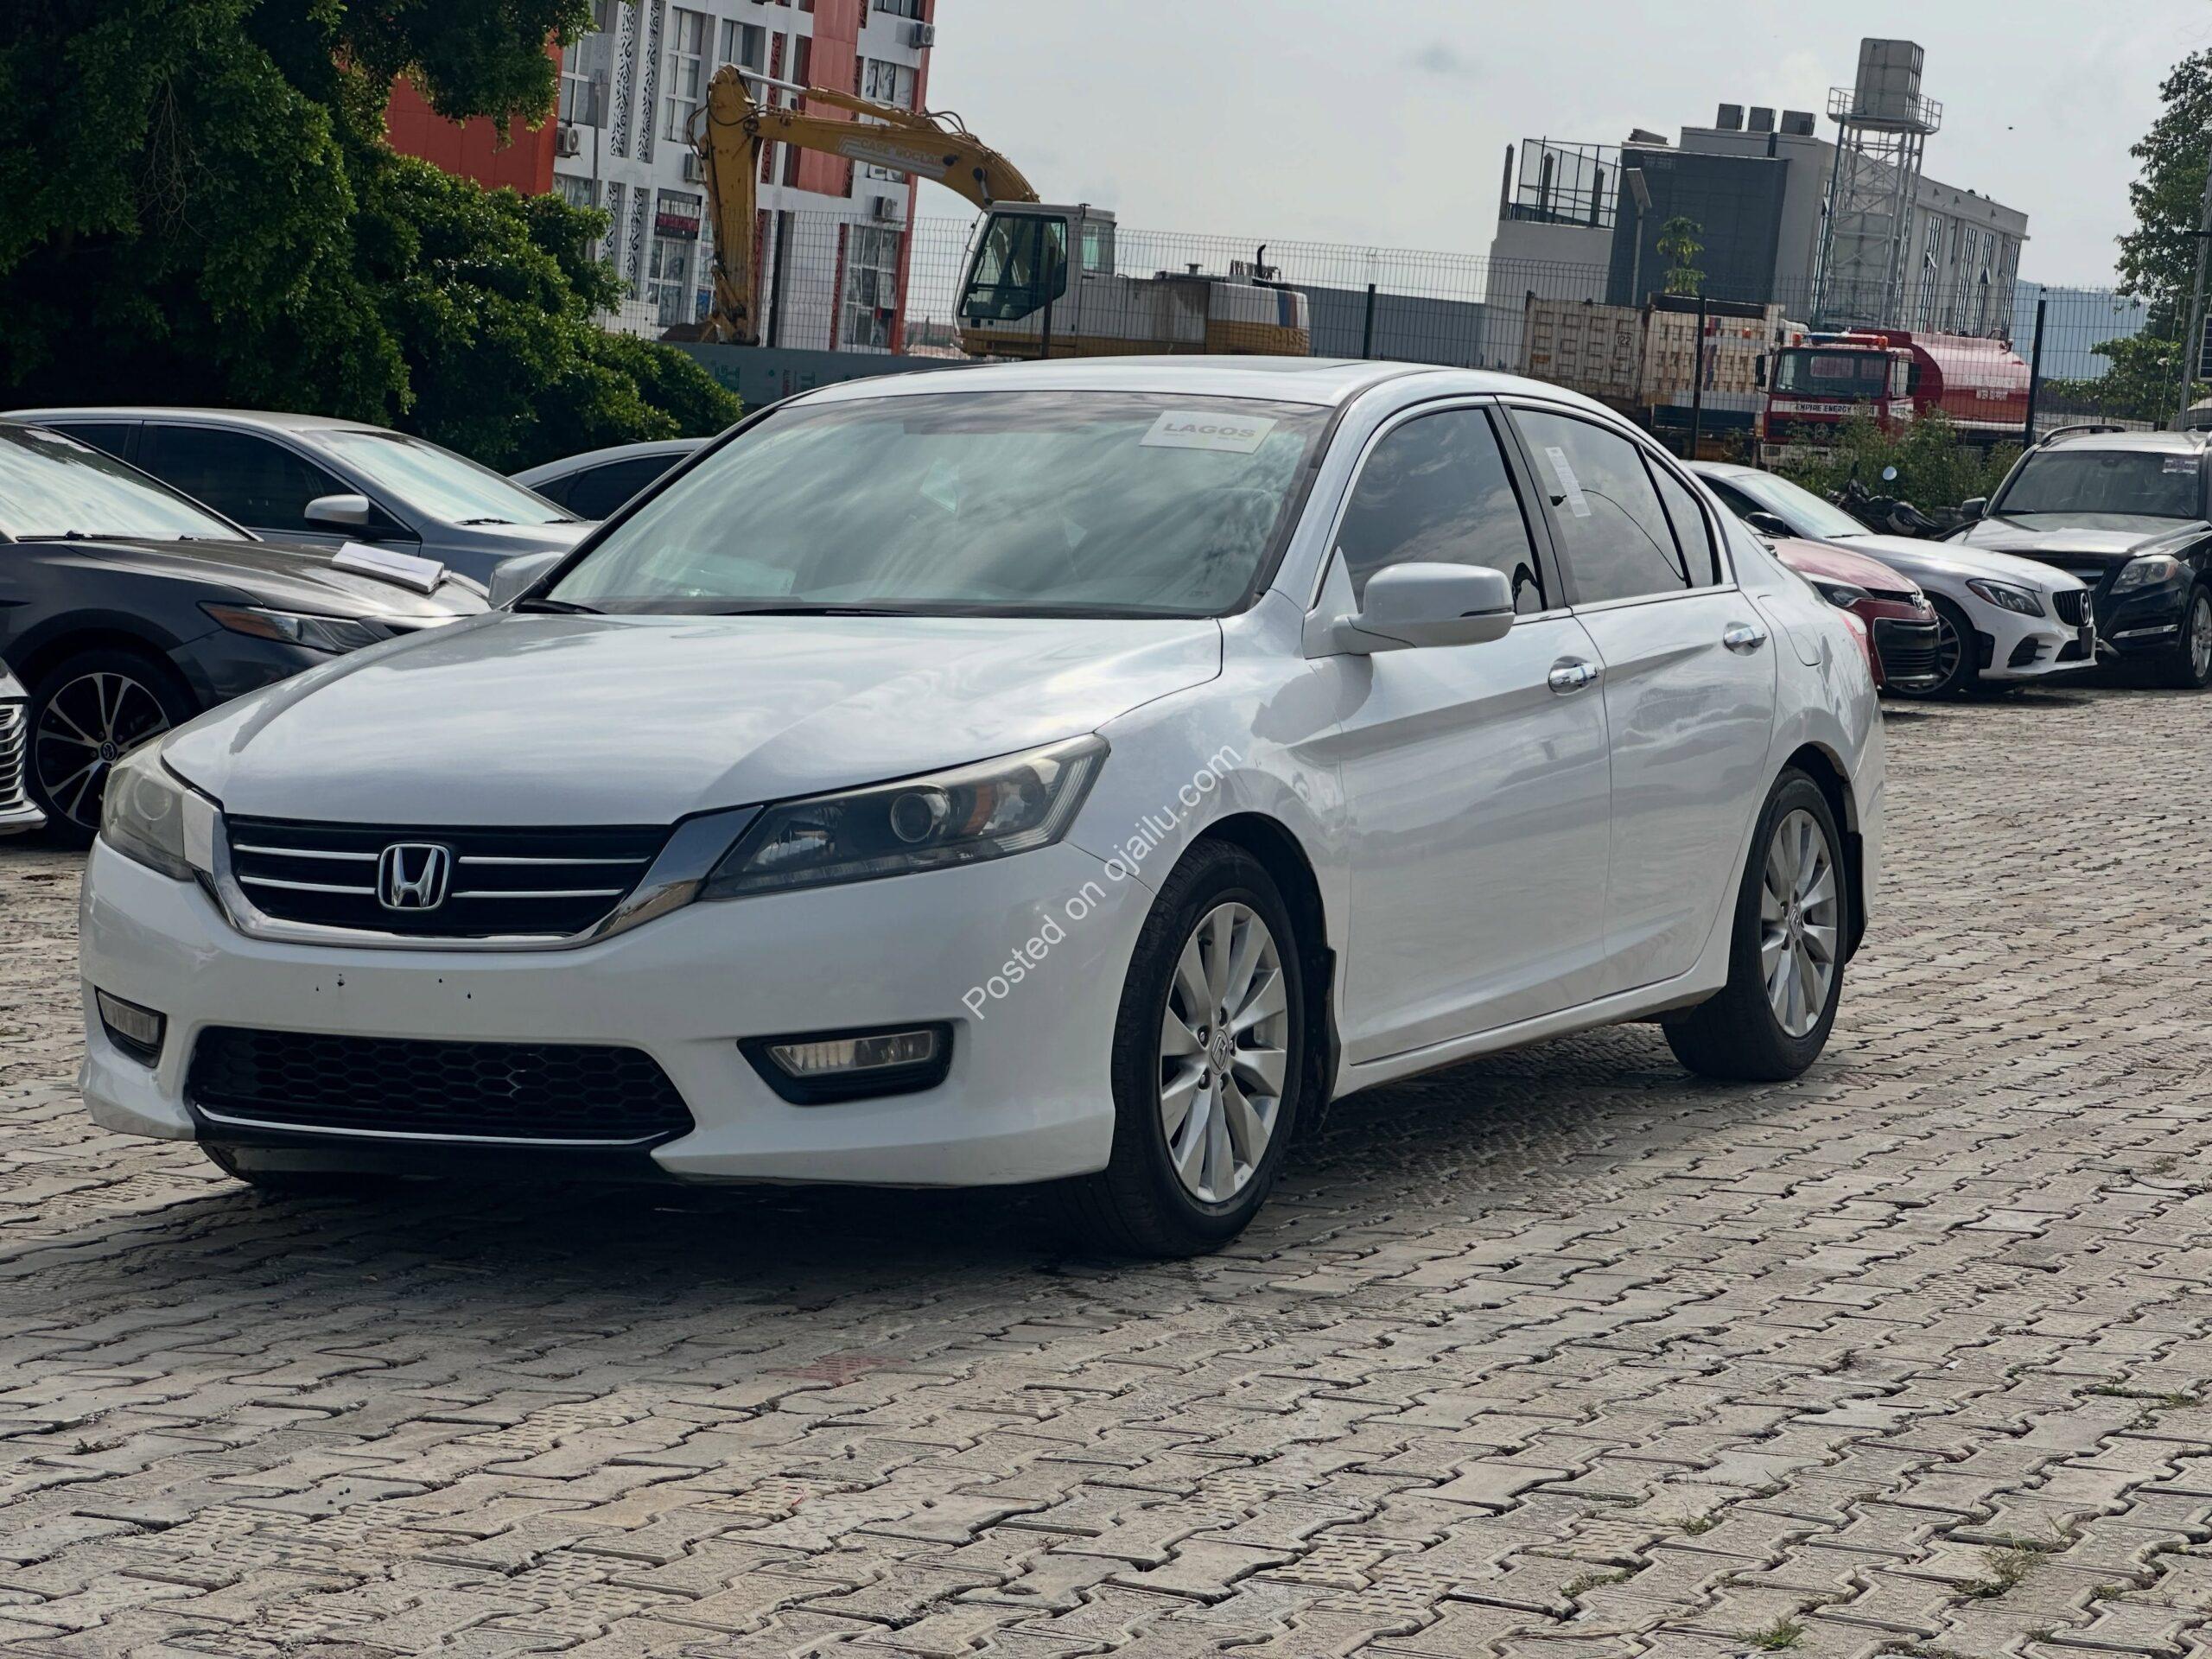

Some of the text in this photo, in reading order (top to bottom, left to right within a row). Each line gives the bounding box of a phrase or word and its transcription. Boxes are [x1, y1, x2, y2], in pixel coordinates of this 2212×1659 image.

[1618, 335, 1631, 346] 122
[1796, 403, 1822, 412] EMPIRE
[1824, 404, 1851, 413] ENERGY
[1164, 423, 1256, 438] LAGOS
